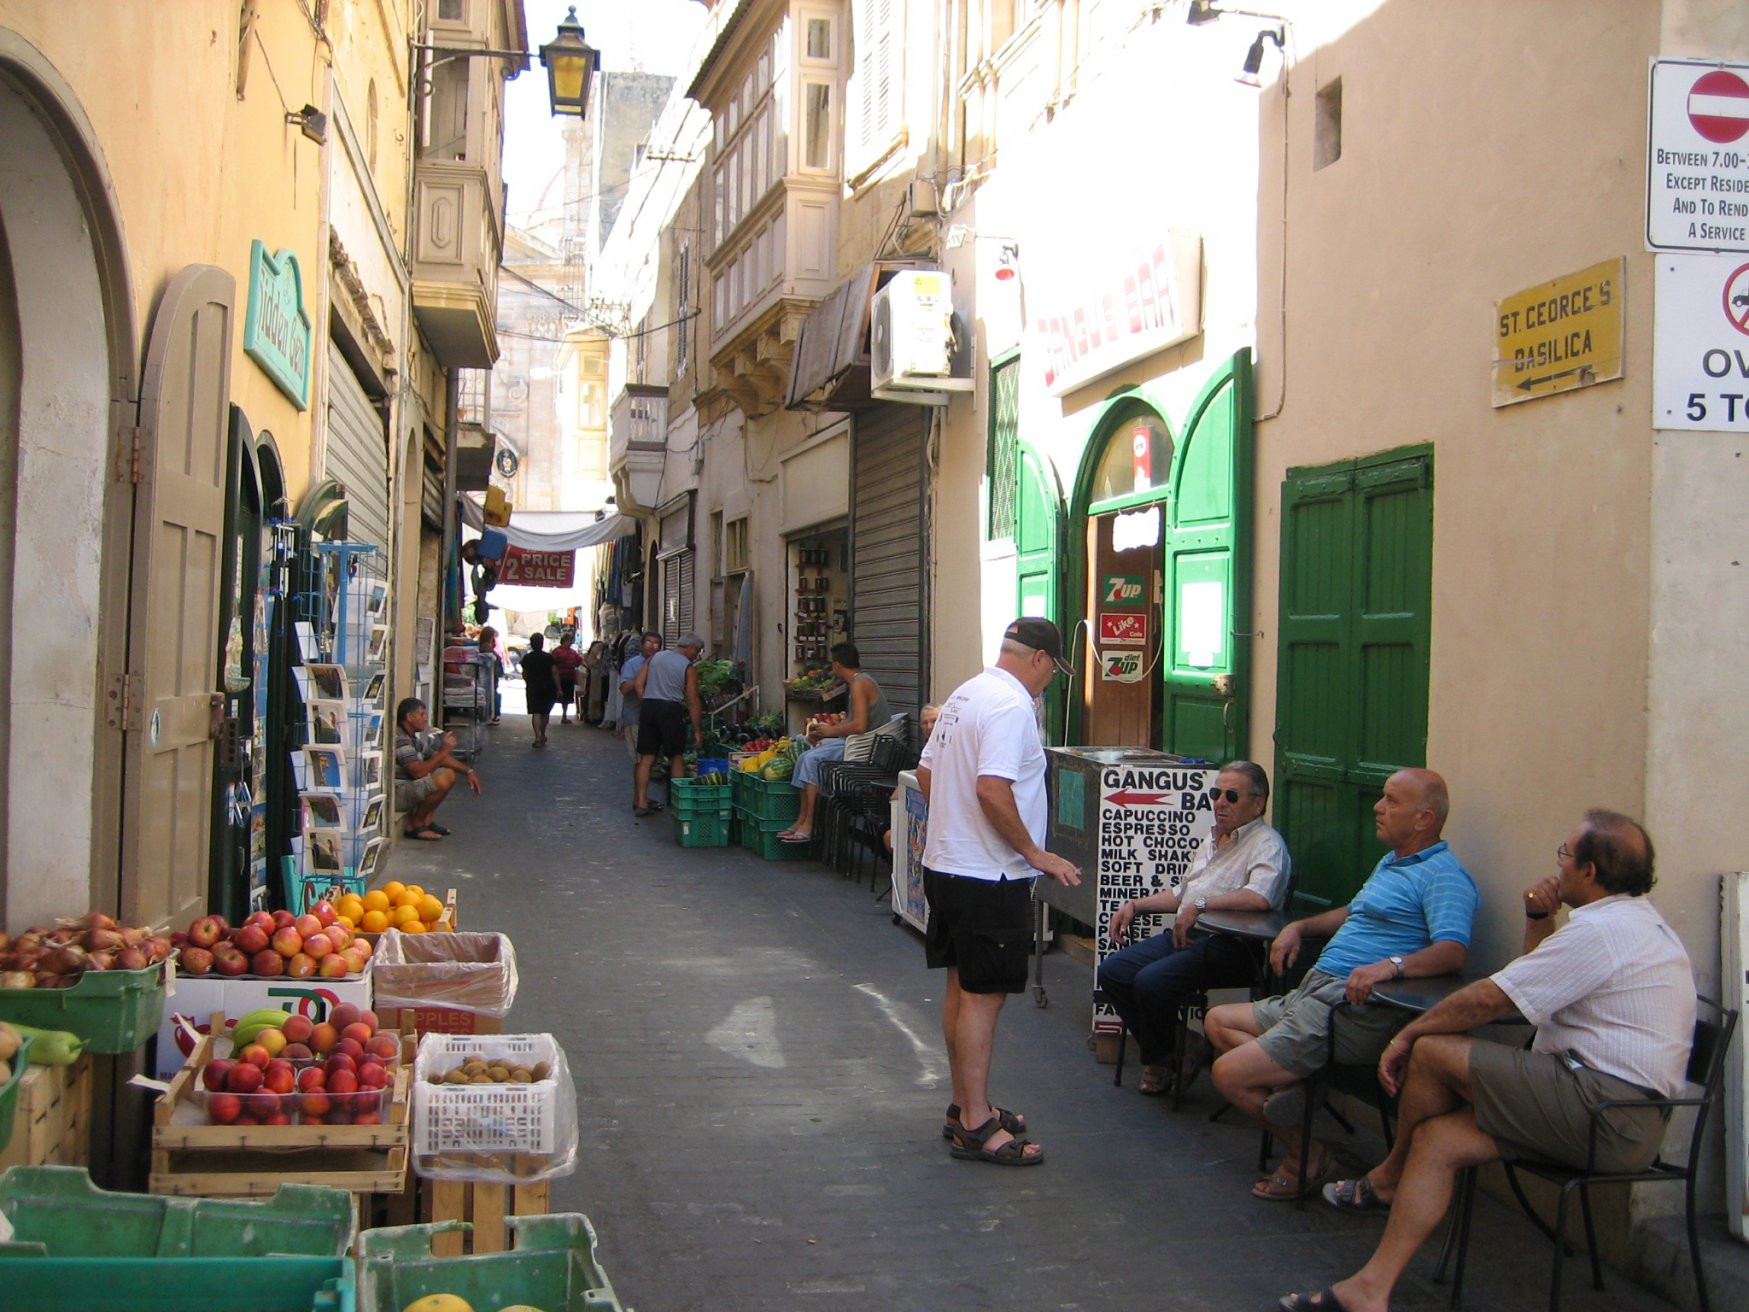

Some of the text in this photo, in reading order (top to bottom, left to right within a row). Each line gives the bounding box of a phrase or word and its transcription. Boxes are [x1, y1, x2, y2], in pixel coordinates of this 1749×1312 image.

[1712, 151, 1749, 169] 7.00-
[1666, 172, 1707, 191] EXCEPT
[1673, 197, 1696, 214] AND
[1688, 222, 1745, 241] A SERVICE
[1686, 392, 1707, 422] 5
[520, 553, 571, 567] PRICE
[524, 566, 567, 581] SALE
[1181, 792, 1212, 811] BA
[1102, 808, 1196, 823] CAPUCCINO
[1101, 822, 1191, 836] ESPRESSO
[1101, 835, 1204, 850] HOT CHOCO
[1101, 848, 1195, 863] MILK SHAK
[1101, 861, 1144, 874] SOFT
[1100, 875, 1144, 887] BEER
[1151, 875, 1163, 888] &
